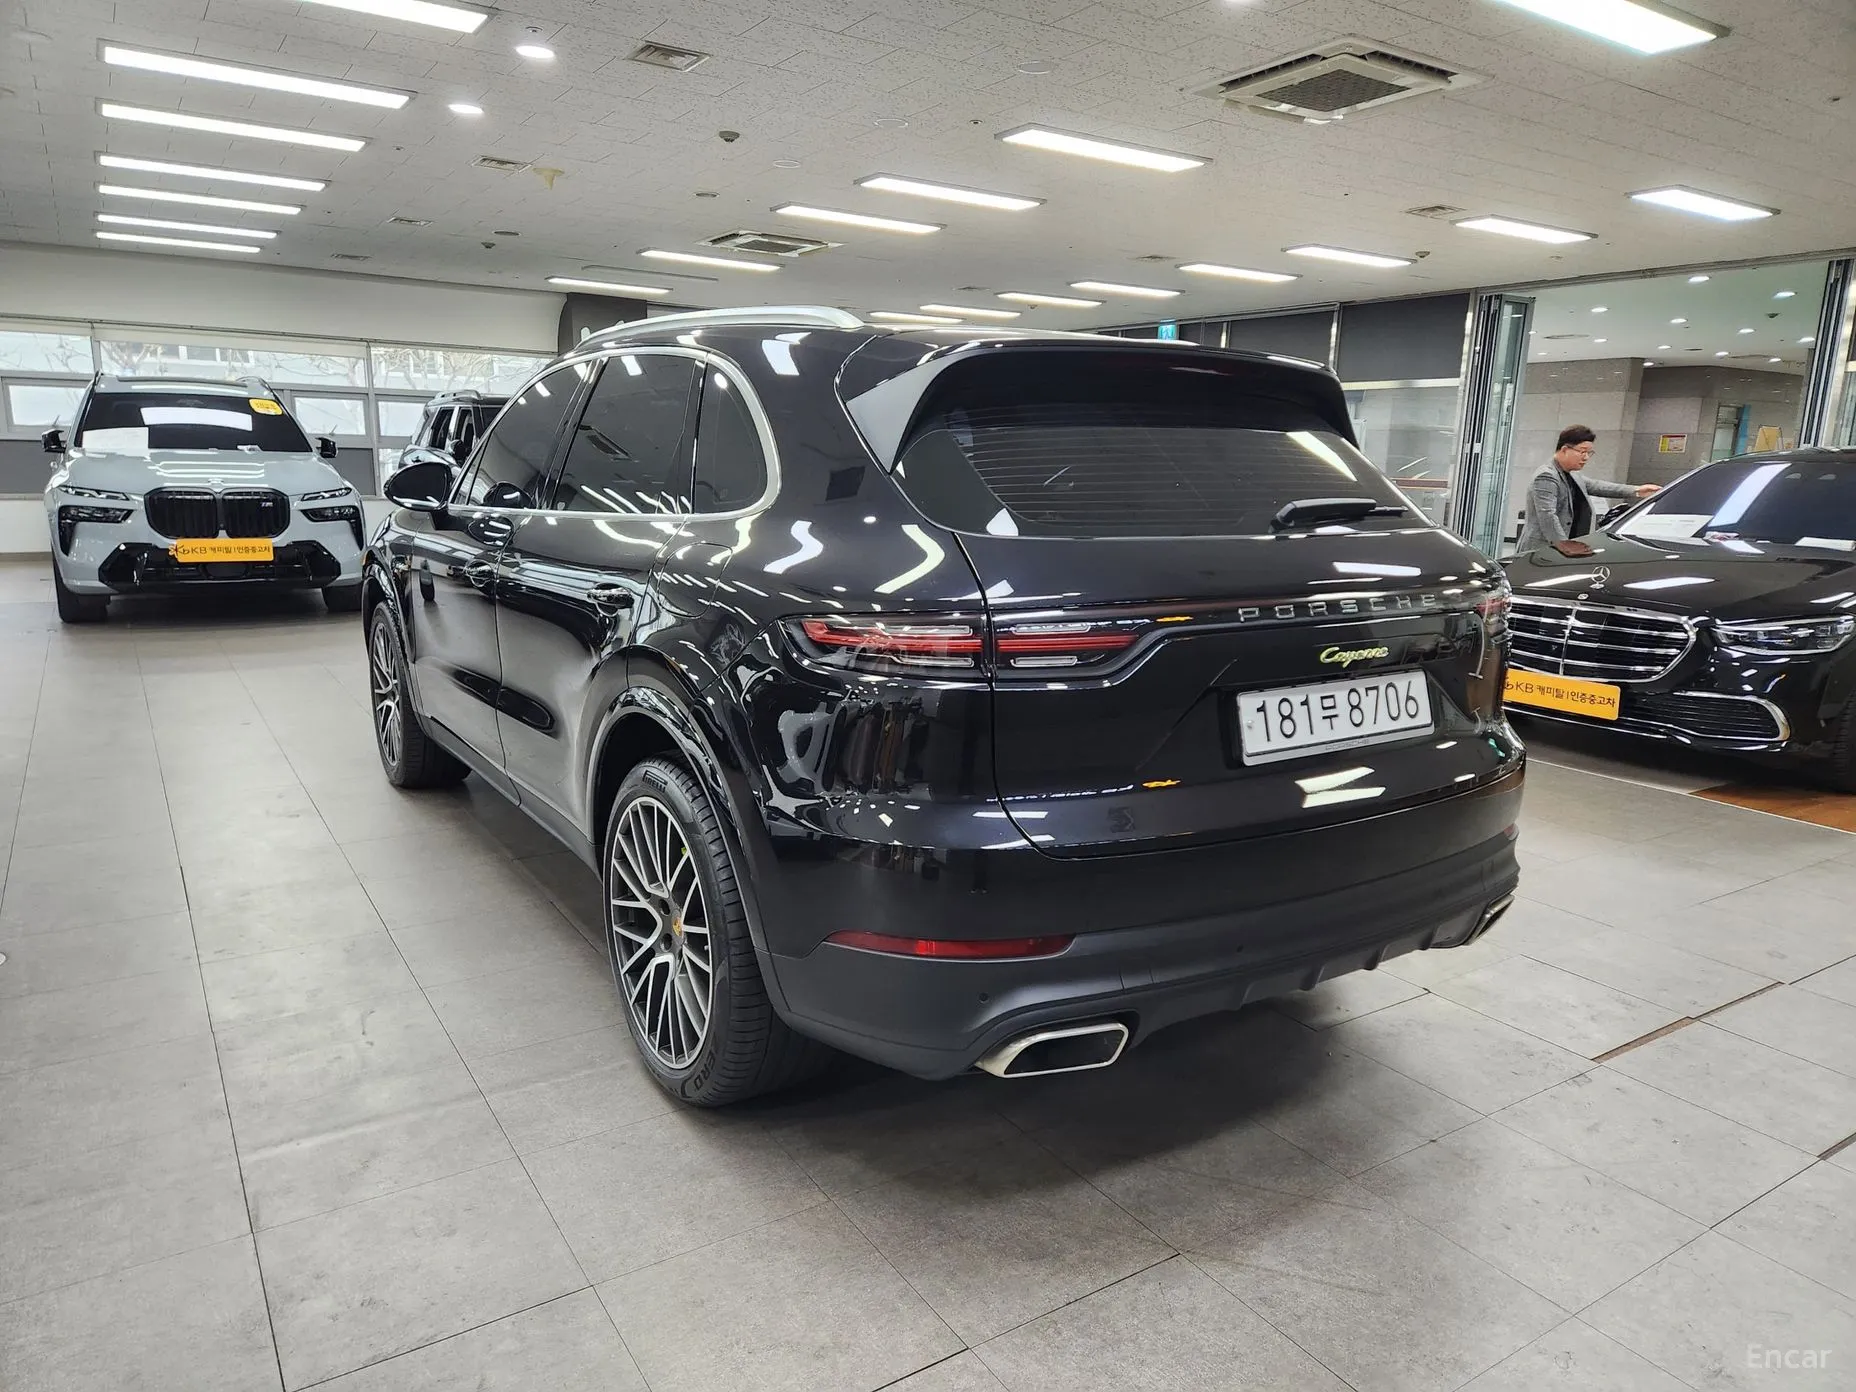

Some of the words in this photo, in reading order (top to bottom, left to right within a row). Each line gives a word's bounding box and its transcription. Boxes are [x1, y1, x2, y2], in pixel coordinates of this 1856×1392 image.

[191, 546, 207, 555] KB
[1238, 594, 1436, 622] PORSCHE
[1319, 646, 1389, 668] Cayenne
[1515, 681, 1534, 694] KB
[1536, 684, 1565, 699] 캐피탈
[1570, 691, 1617, 708] 인증중고차
[1256, 680, 1419, 742] 181무8706
